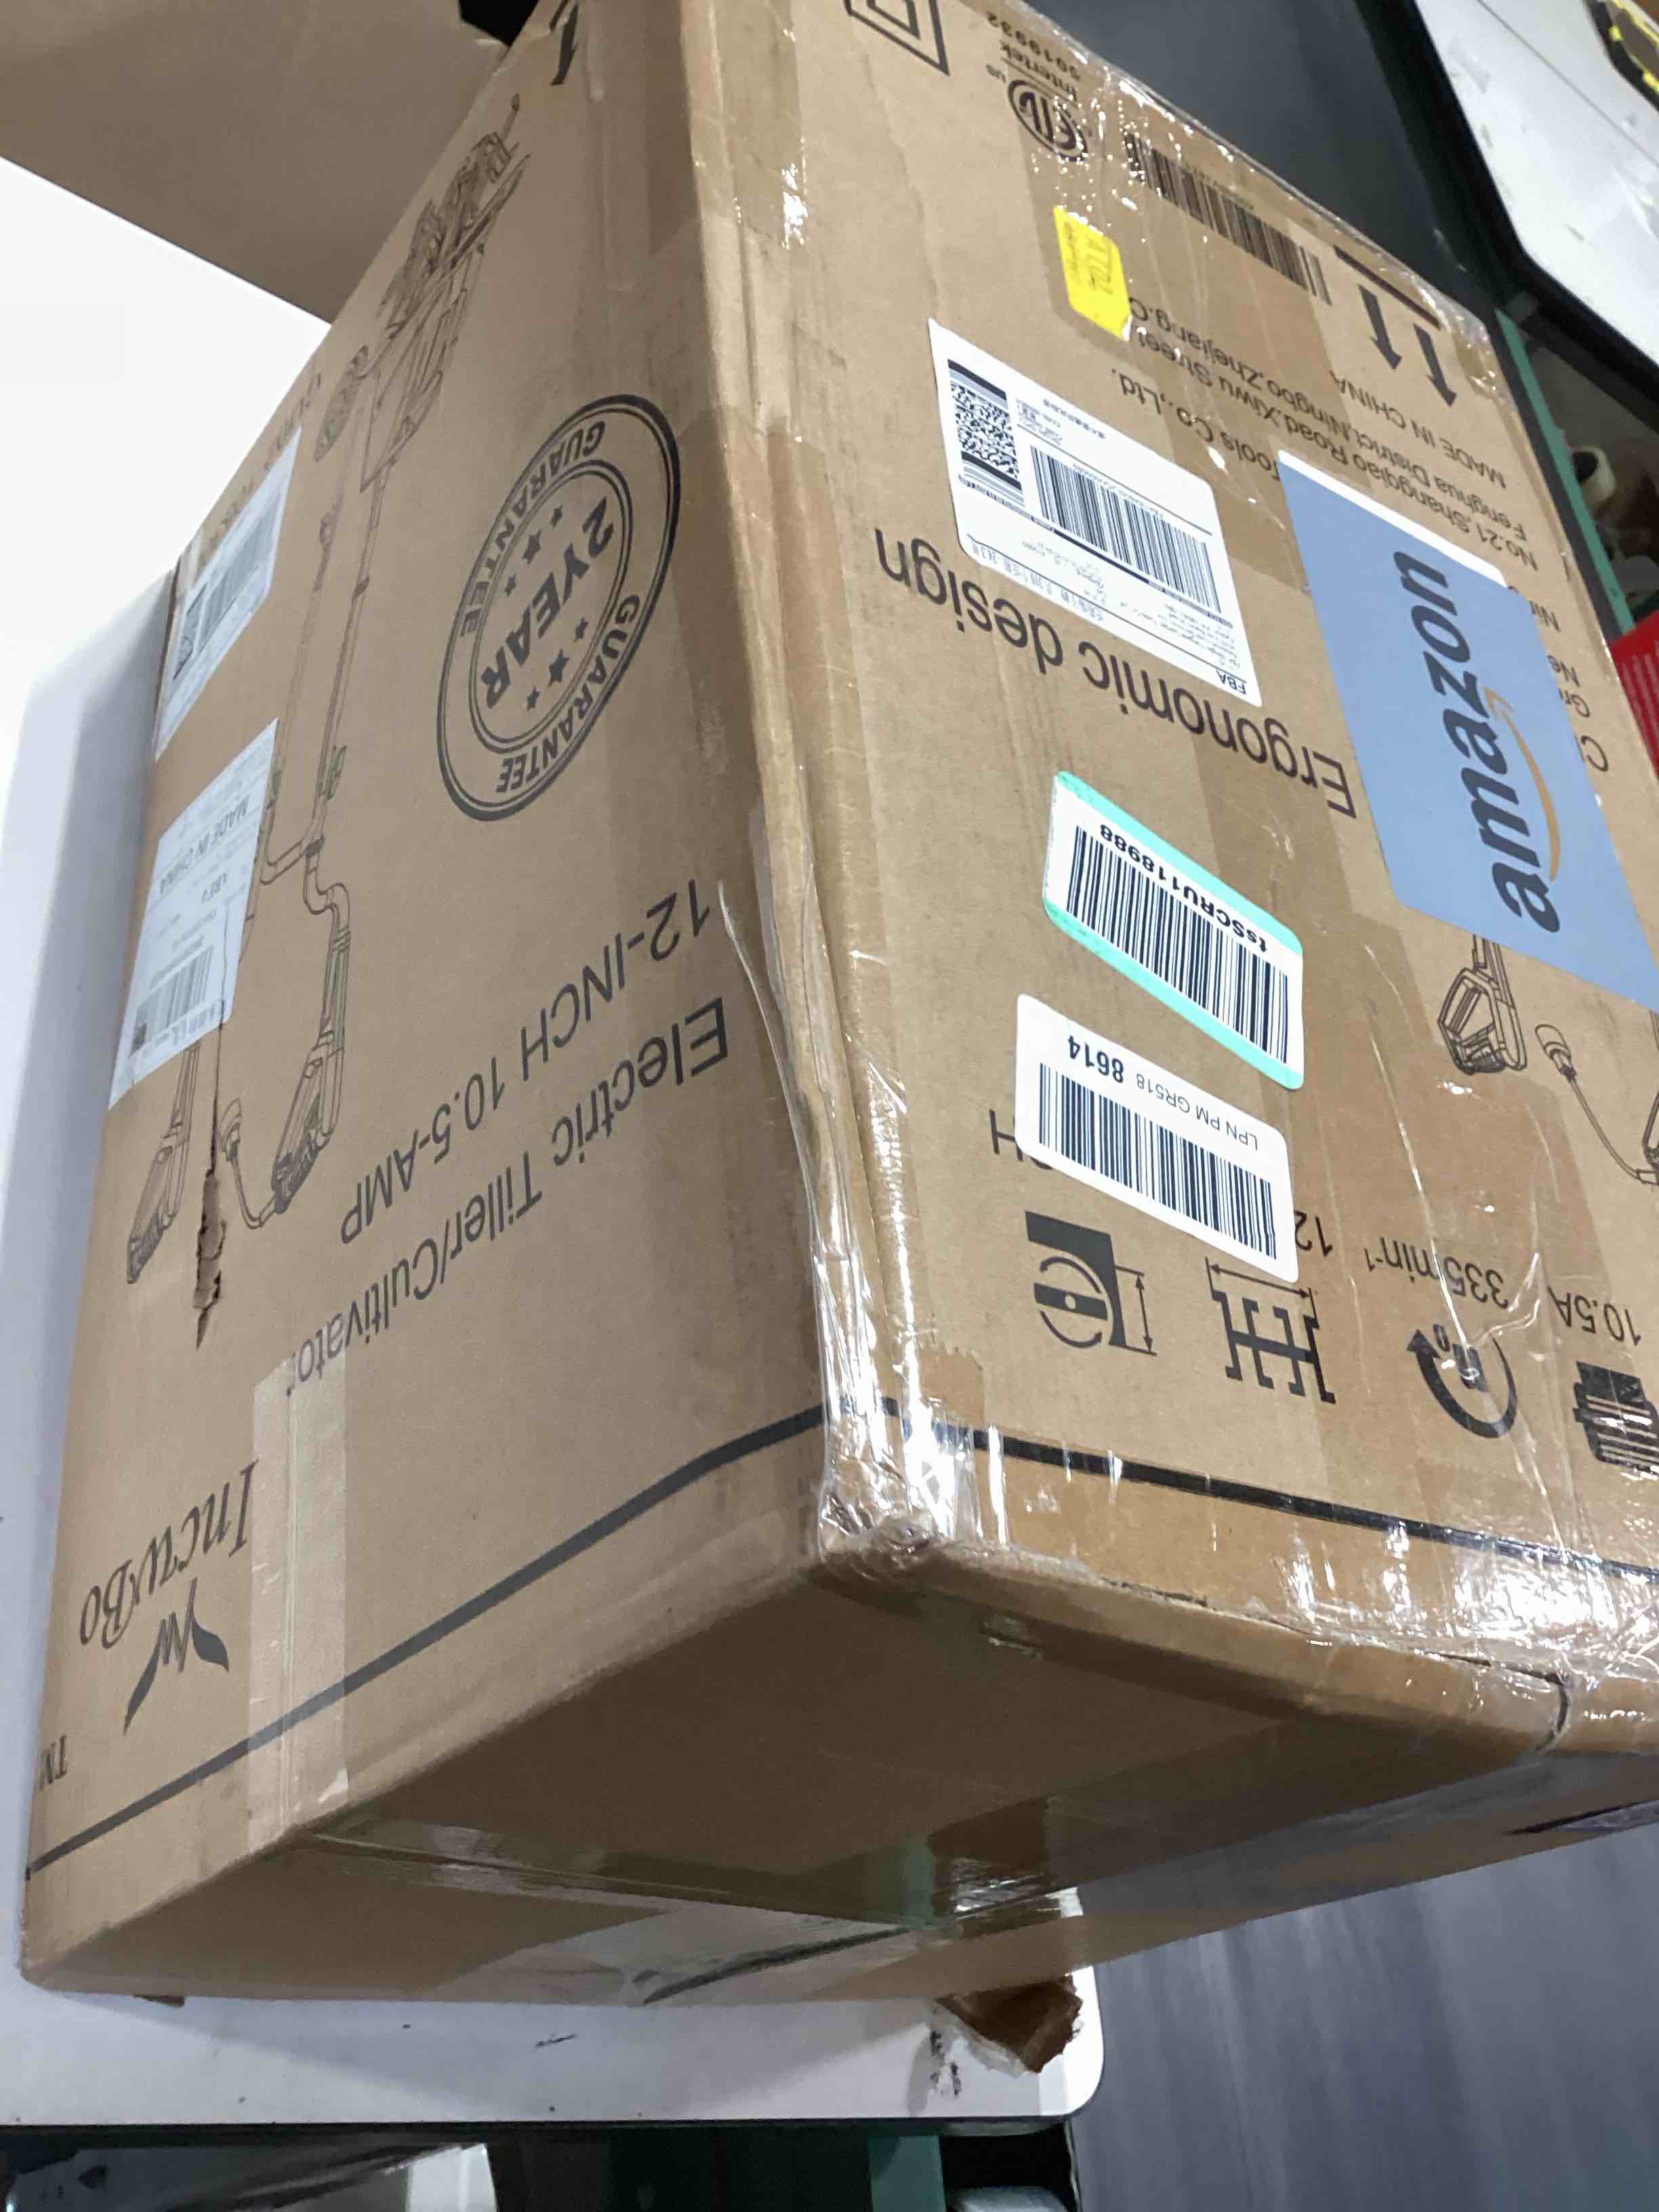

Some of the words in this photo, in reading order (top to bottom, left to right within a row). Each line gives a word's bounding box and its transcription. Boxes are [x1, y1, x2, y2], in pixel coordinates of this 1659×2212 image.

[999, 39, 1078, 102] Intertek
[1329, 370, 1406, 429] CHINA
[1411, 419, 1436, 448] IN
[1439, 436, 1506, 489] MADE
[459, 420, 606, 638] GUARANTEE
[874, 527, 1063, 675] design
[495, 594, 641, 794] GUARANTEE
[1216, 668, 1248, 695] FBA
[1078, 641, 1357, 819] Ergonomic
[1393, 550, 1561, 933] amazon
[1099, 824, 1268, 953] tsSCRU118988
[520, 879, 710, 1082] 12-INCH
[551, 996, 729, 1167] Electric
[1067, 1035, 1124, 1084] 8614
[1136, 1073, 1191, 1114] GR518
[1196, 1105, 1221, 1130] PM
[340, 1057, 506, 1244] 10.5-AMP
[1226, 1120, 1259, 1151] LPN
[1547, 1285, 1641, 1347] 10.5A
